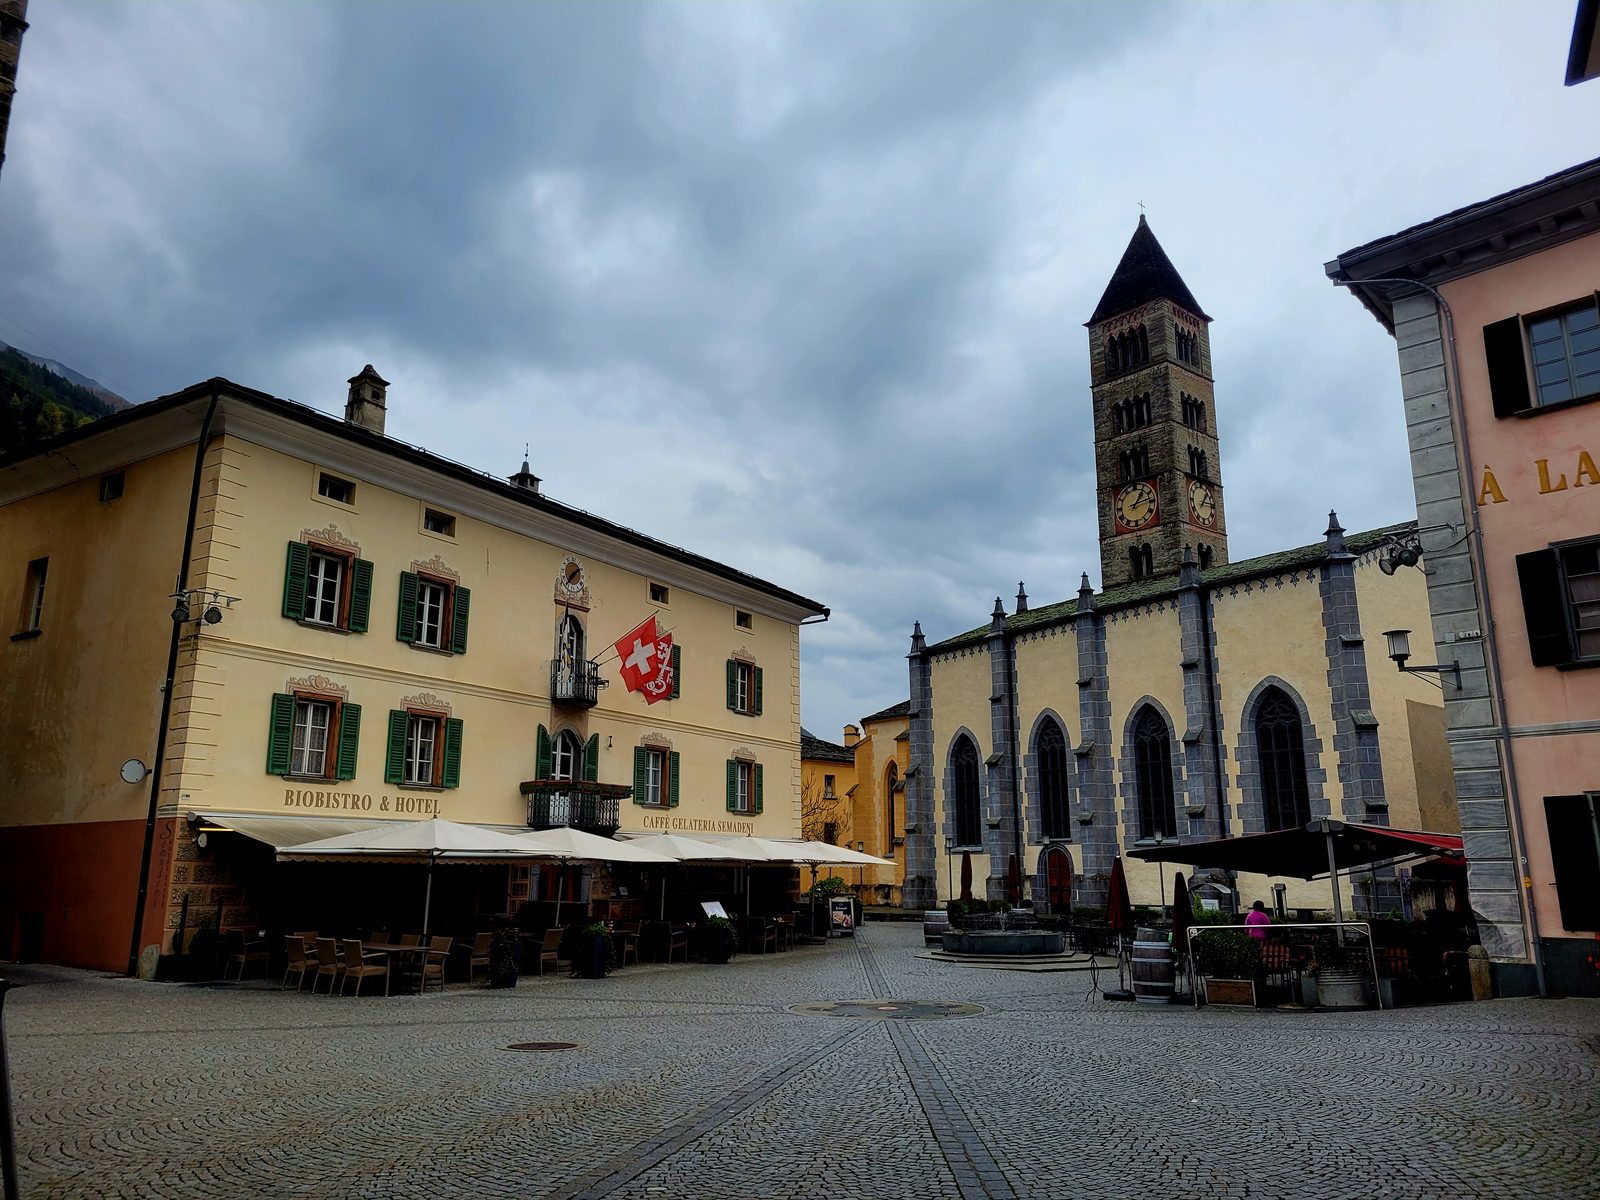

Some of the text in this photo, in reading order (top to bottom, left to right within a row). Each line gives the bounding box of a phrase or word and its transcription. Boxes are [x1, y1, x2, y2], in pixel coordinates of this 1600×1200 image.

[1534, 450, 1600, 494] LA
[284, 789, 441, 814] BIOBISTRO & HOTEL
[643, 815, 754, 834] CAFFÈ GELATERIA SEMADENI
